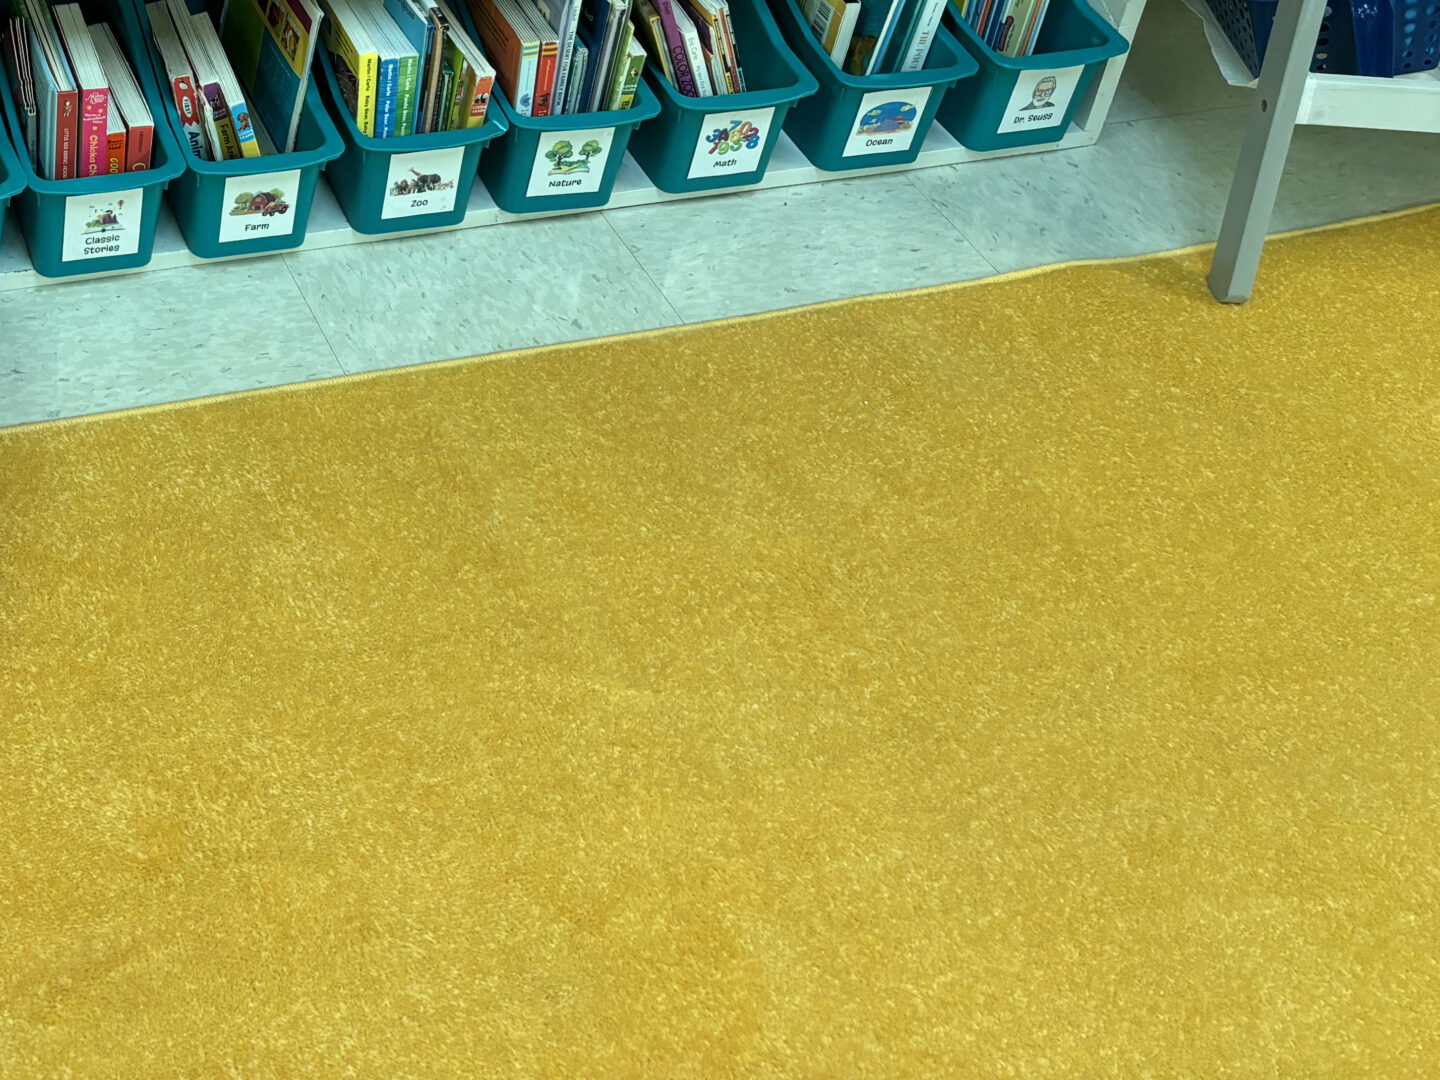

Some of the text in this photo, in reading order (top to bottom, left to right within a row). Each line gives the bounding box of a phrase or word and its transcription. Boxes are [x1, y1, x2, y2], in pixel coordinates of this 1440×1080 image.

[566, 30, 574, 41] THE
[686, 37, 695, 47] Eric
[563, 41, 572, 60] DESERT
[690, 46, 699, 61] Carle
[561, 61, 569, 72] FOX
[672, 45, 689, 79] COLOR
[386, 63, 394, 80] Martin
[183, 98, 192, 116] FIRST
[1013, 111, 1054, 124] Dr. Seuss
[220, 124, 231, 145] Farm
[865, 136, 894, 147] Ocean
[87, 134, 98, 162] Chicka
[713, 158, 737, 168] Math
[548, 177, 583, 188] Nature
[410, 197, 428, 208] Zoo
[244, 221, 270, 232] Farm
[85, 234, 120, 245] Classic
[83, 245, 120, 255] Stories
